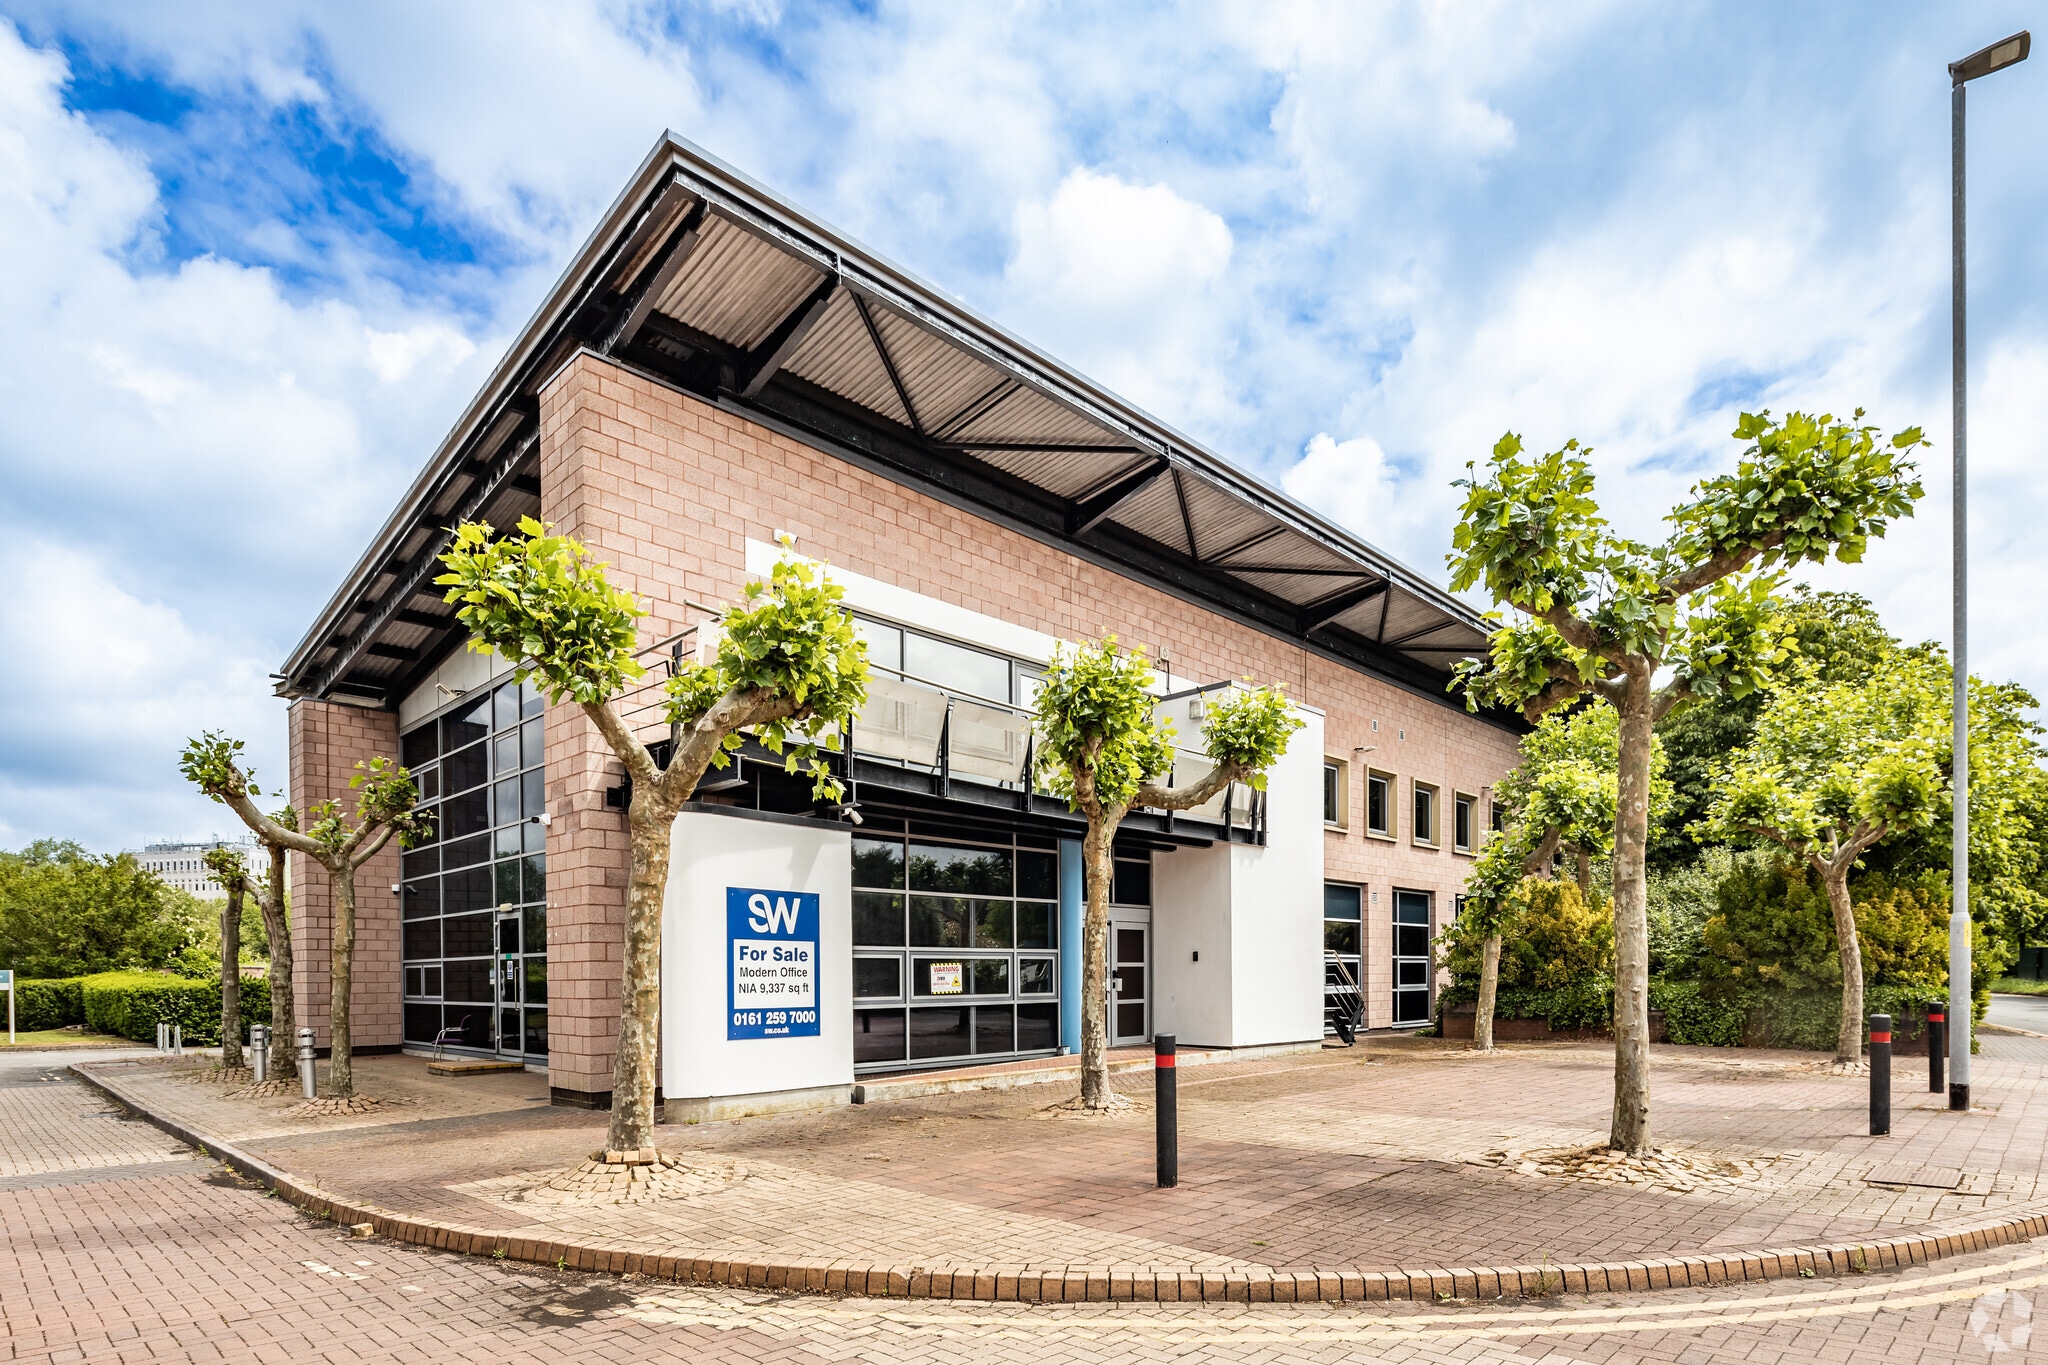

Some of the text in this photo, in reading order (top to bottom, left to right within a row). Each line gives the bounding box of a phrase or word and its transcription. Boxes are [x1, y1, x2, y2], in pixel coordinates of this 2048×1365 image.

[748, 894, 801, 934] SW
[740, 946, 808, 962] For Sale
[740, 967, 807, 977] Modern Office
[739, 983, 809, 995] NIA 9,337 sq ft
[734, 1011, 815, 1026] 0161 259 7000
[764, 1026, 790, 1034] sw.co.uk
